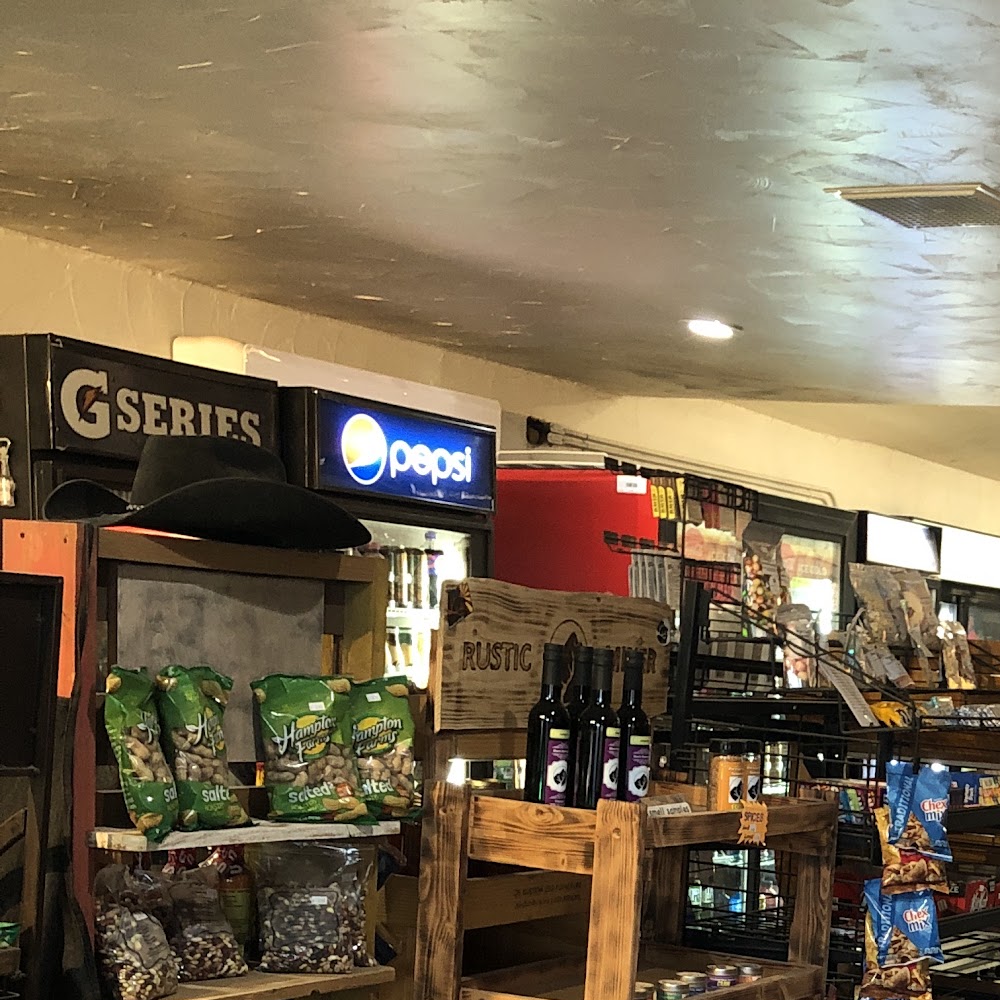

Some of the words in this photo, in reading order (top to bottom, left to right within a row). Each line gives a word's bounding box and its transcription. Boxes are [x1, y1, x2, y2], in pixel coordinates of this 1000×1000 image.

[60, 368, 111, 440] G
[116, 387, 261, 447] SERIES
[389, 439, 472, 486] pepsi
[462, 641, 532, 672] RUSTIC
[163, 786, 177, 802] sal
[288, 782, 334, 804] salted
[894, 775, 914, 832] TRADITIONAL
[921, 800, 948, 811] Chex
[903, 908, 929, 921] Chex
[909, 920, 931, 932] mix
